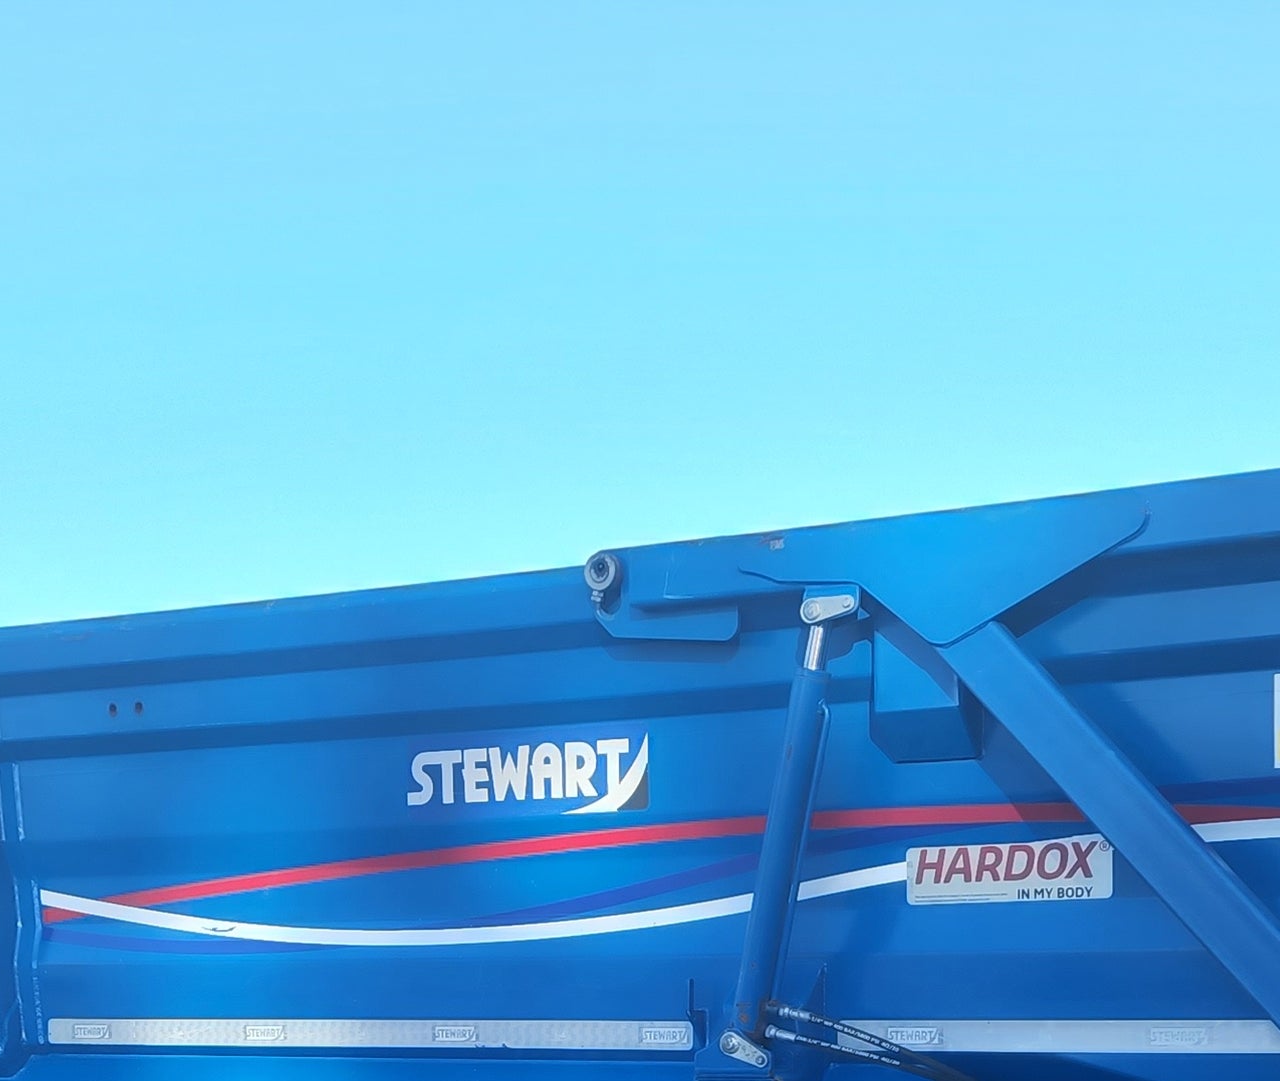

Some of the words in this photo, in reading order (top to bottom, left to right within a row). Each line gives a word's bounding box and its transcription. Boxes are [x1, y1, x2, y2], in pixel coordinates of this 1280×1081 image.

[407, 731, 649, 815] STEWART
[1017, 888, 1030, 899] IN
[1033, 887, 1054, 899] MY
[1057, 886, 1093, 898] BODY
[889, 1029, 941, 1044] STEWART
